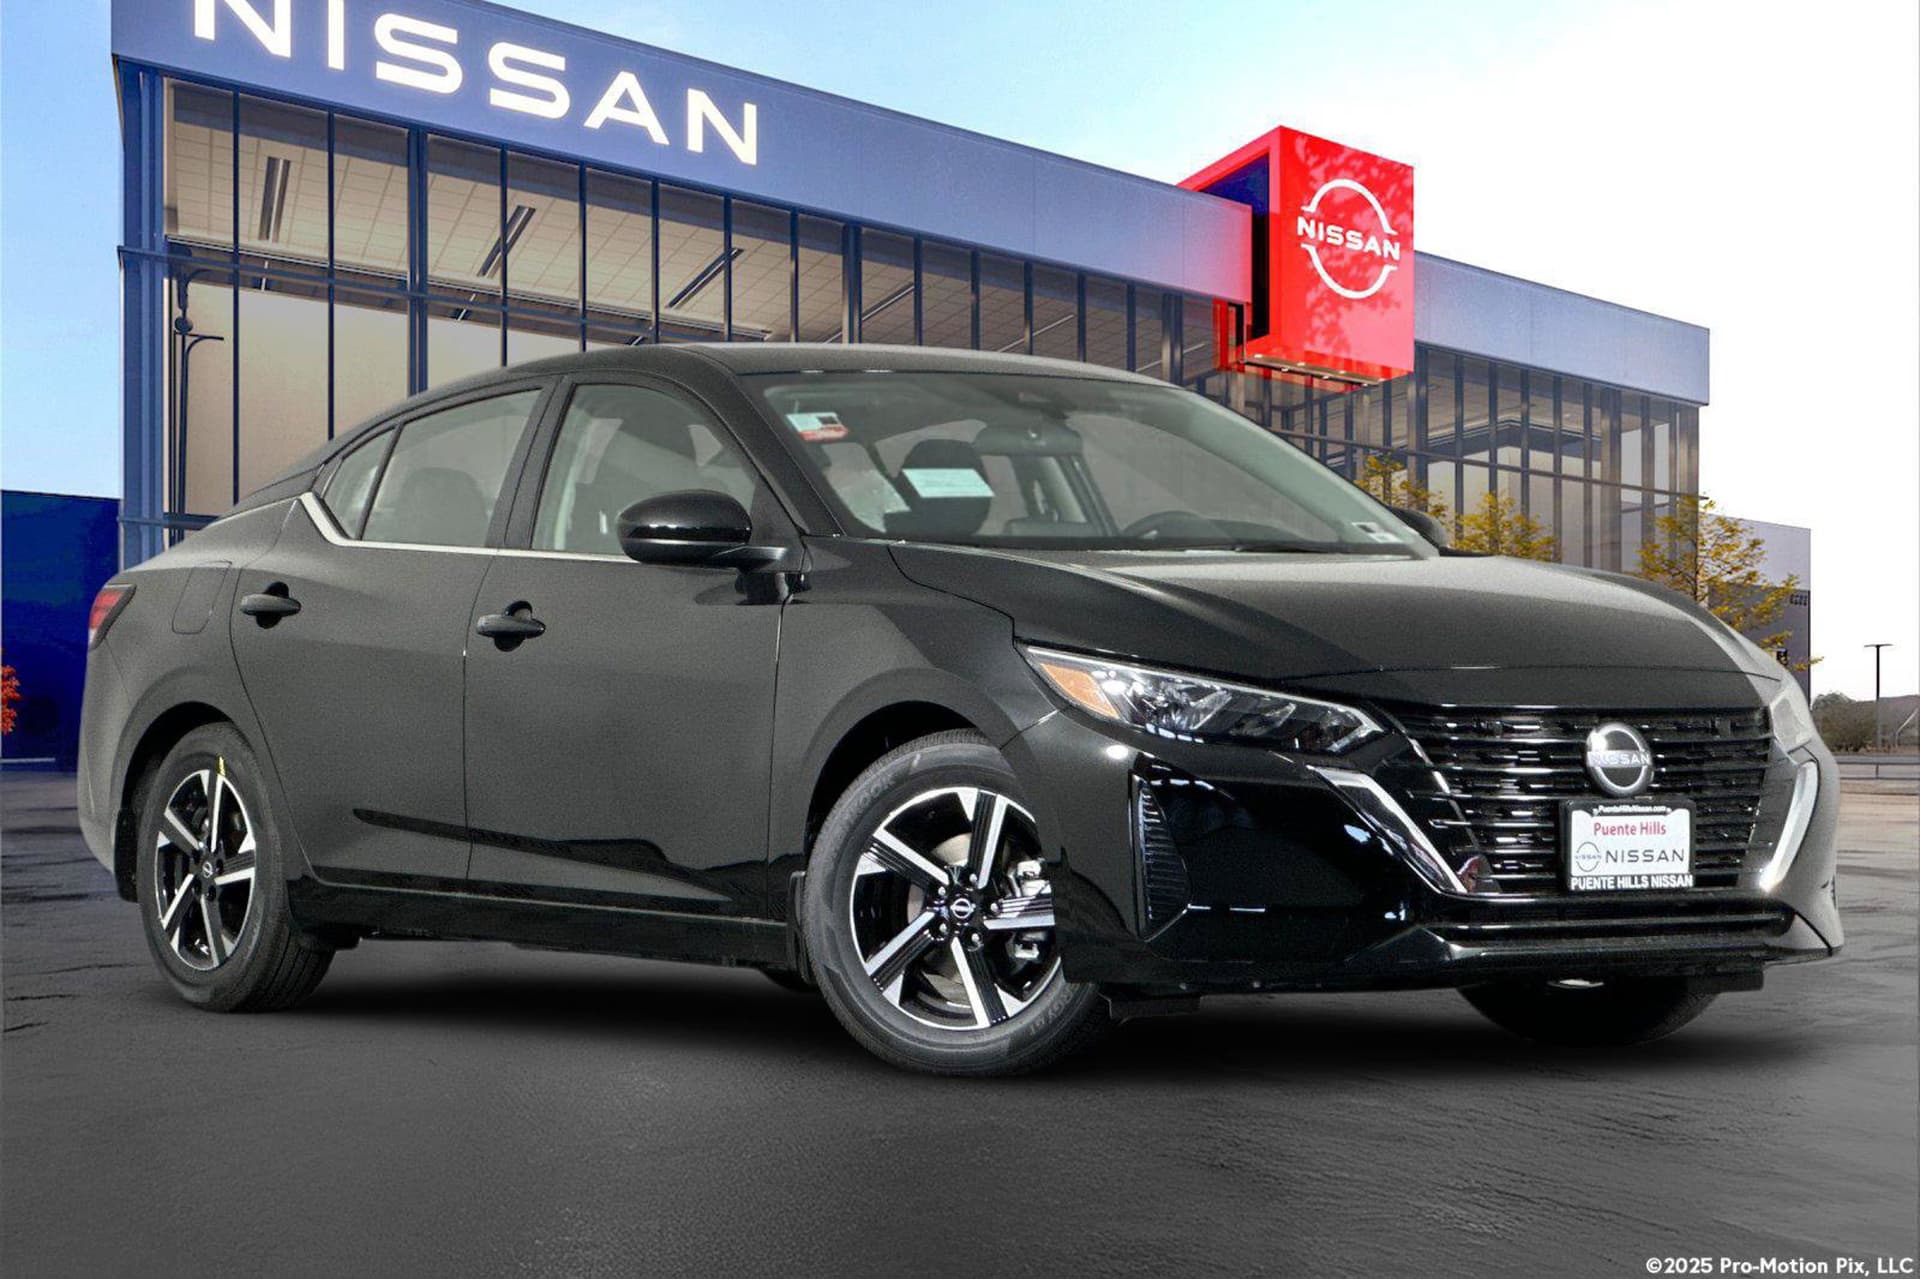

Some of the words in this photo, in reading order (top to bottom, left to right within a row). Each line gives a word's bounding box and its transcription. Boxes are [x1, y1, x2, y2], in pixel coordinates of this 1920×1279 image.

[193, 0, 758, 166] NISSAN
[1297, 215, 1400, 261] NISSAN
[1594, 822, 1637, 835] Puente
[1640, 822, 1666, 835] Hills
[1605, 850, 1684, 863] NISSAN
[1571, 877, 1615, 890] PUENTE
[1617, 876, 1649, 889] HILLS
[1651, 874, 1693, 888] NISSAN
